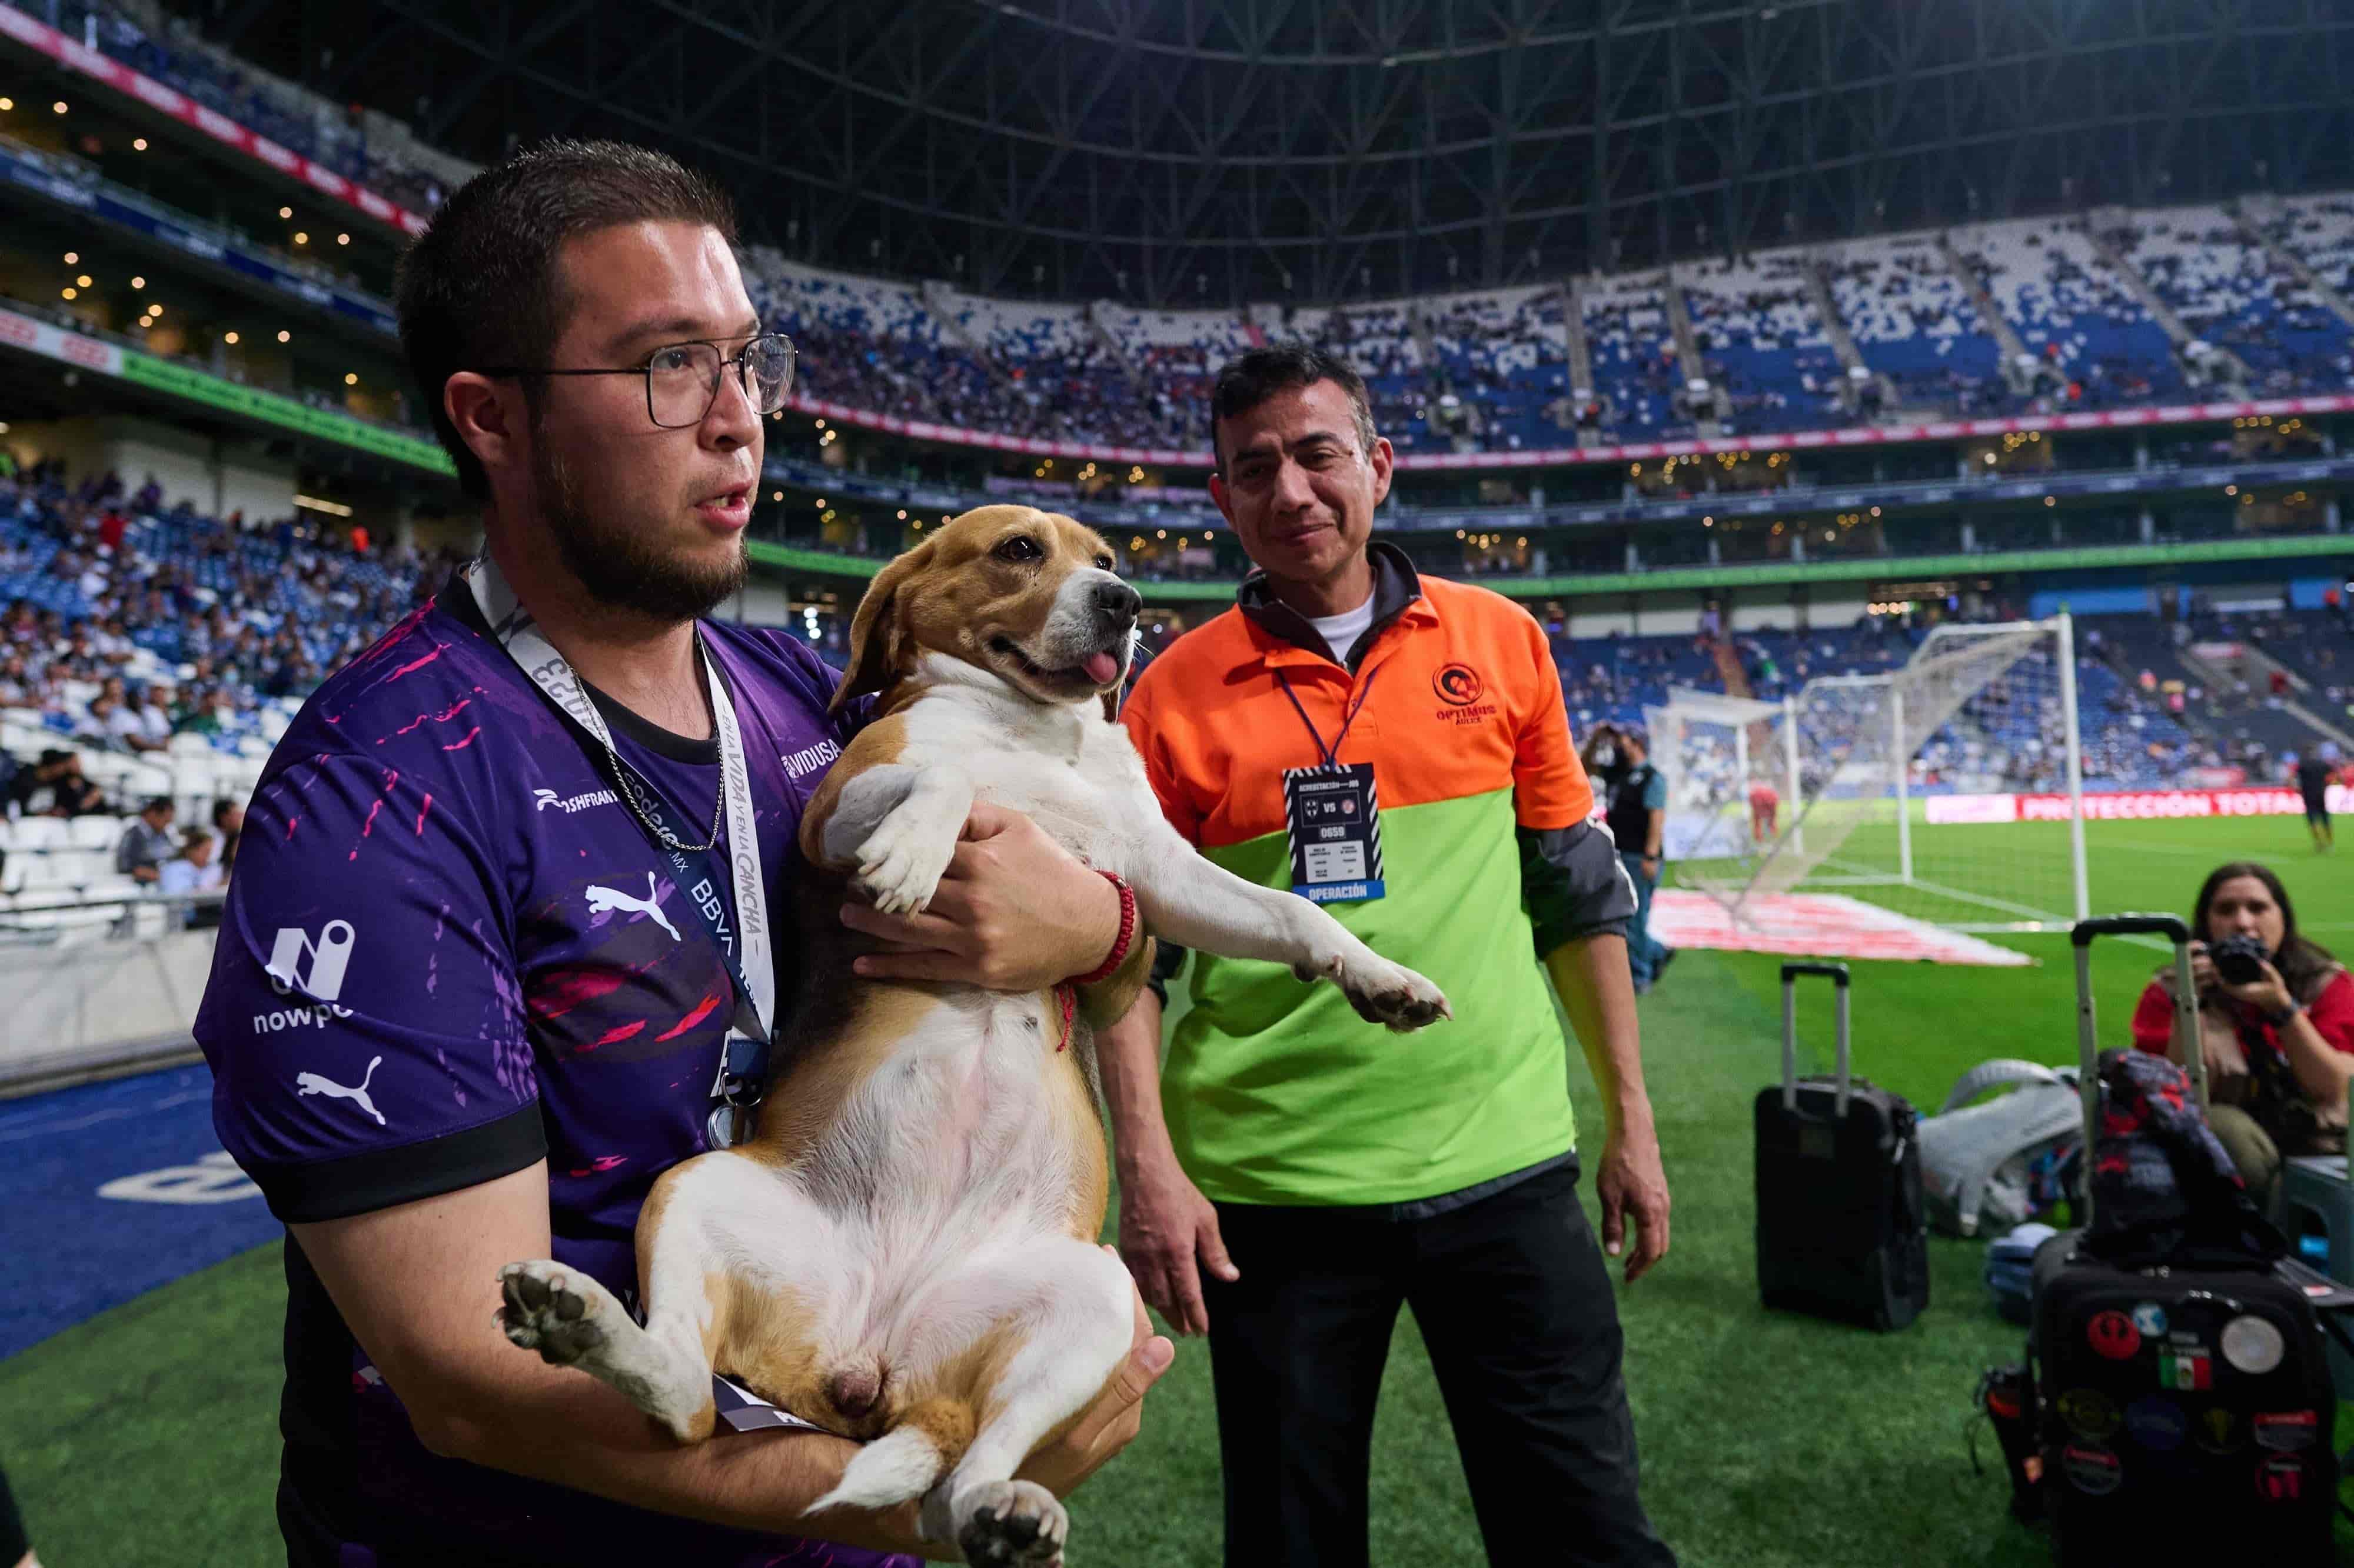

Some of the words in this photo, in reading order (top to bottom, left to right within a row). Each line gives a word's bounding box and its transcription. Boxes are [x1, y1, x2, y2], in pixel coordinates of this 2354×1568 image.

[1437, 705, 1497, 720] OPTIMUS
[728, 753, 747, 804] VIDA
[736, 853, 762, 934] CANCHA
[1308, 883, 1367, 900] OPERACIÓN
[691, 878, 733, 957] BBVA
